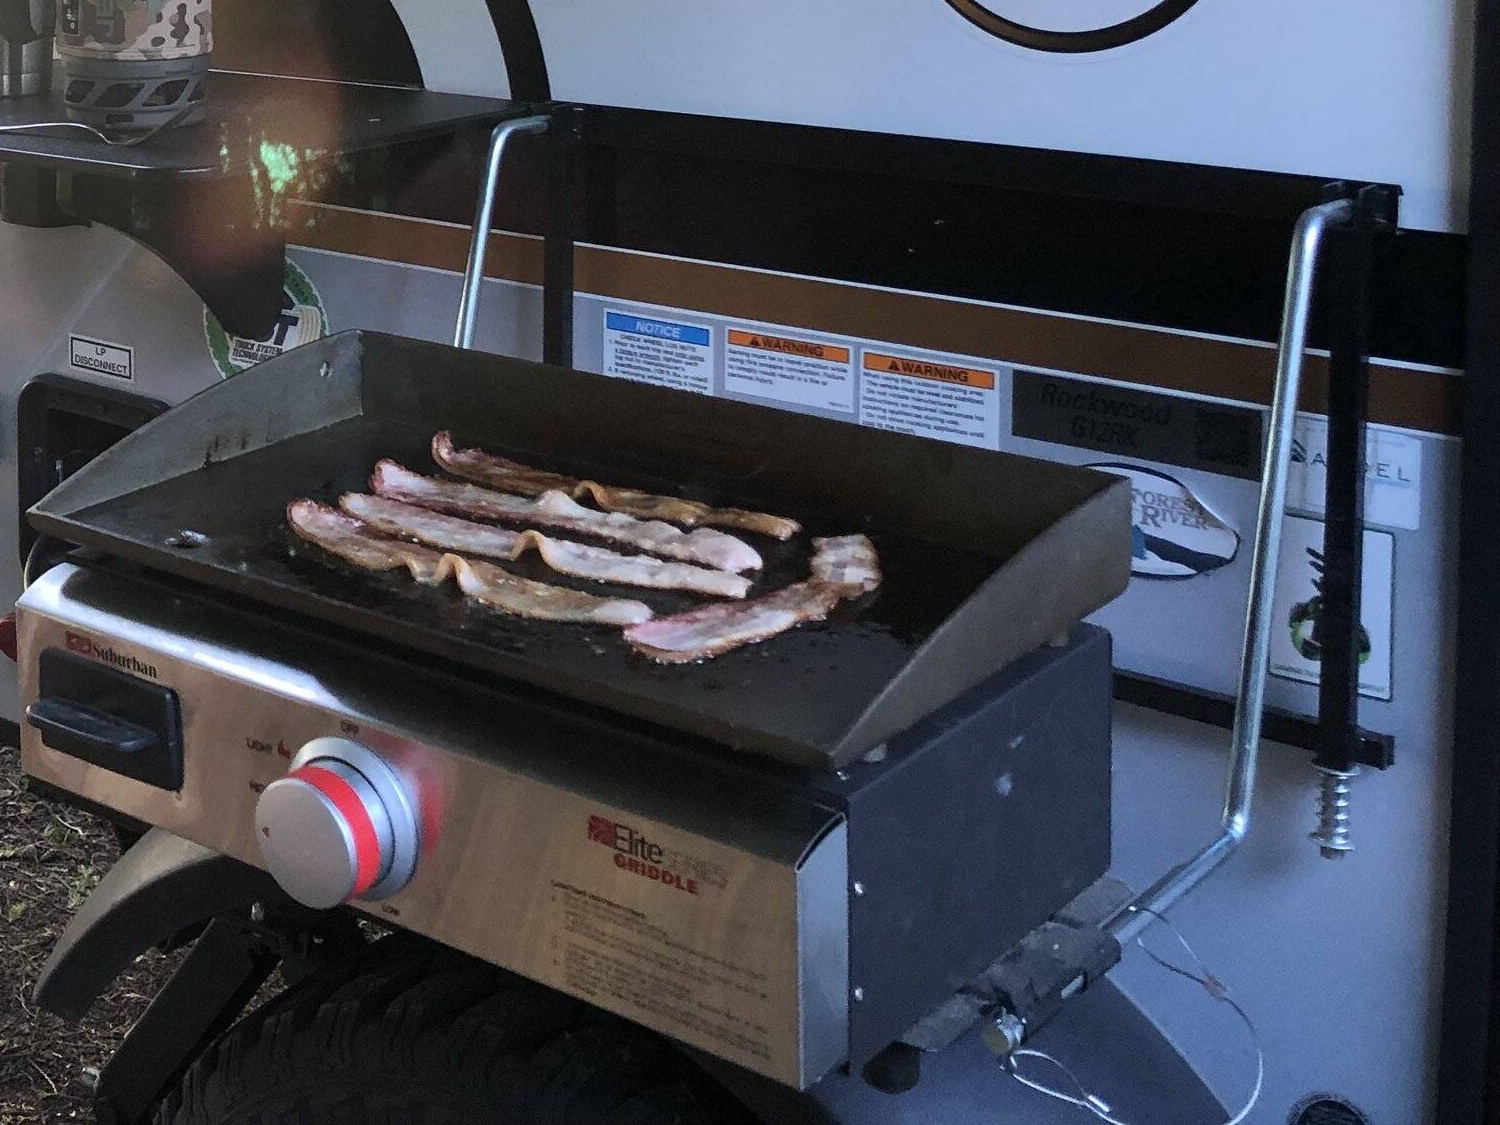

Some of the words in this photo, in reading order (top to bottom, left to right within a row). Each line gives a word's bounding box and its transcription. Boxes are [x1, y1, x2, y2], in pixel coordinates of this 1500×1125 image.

[635, 321, 682, 339] NOTICE
[95, 346, 106, 357] LP
[762, 338, 824, 357] WARNING
[74, 355, 128, 375] DISCONNECT
[900, 361, 969, 383] WARNING
[1040, 382, 1175, 427] Rockwood
[1311, 452, 1411, 483] AEL
[92, 641, 157, 679] Suburban
[613, 822, 663, 865] Elite
[613, 853, 699, 895] GRIDDLE
